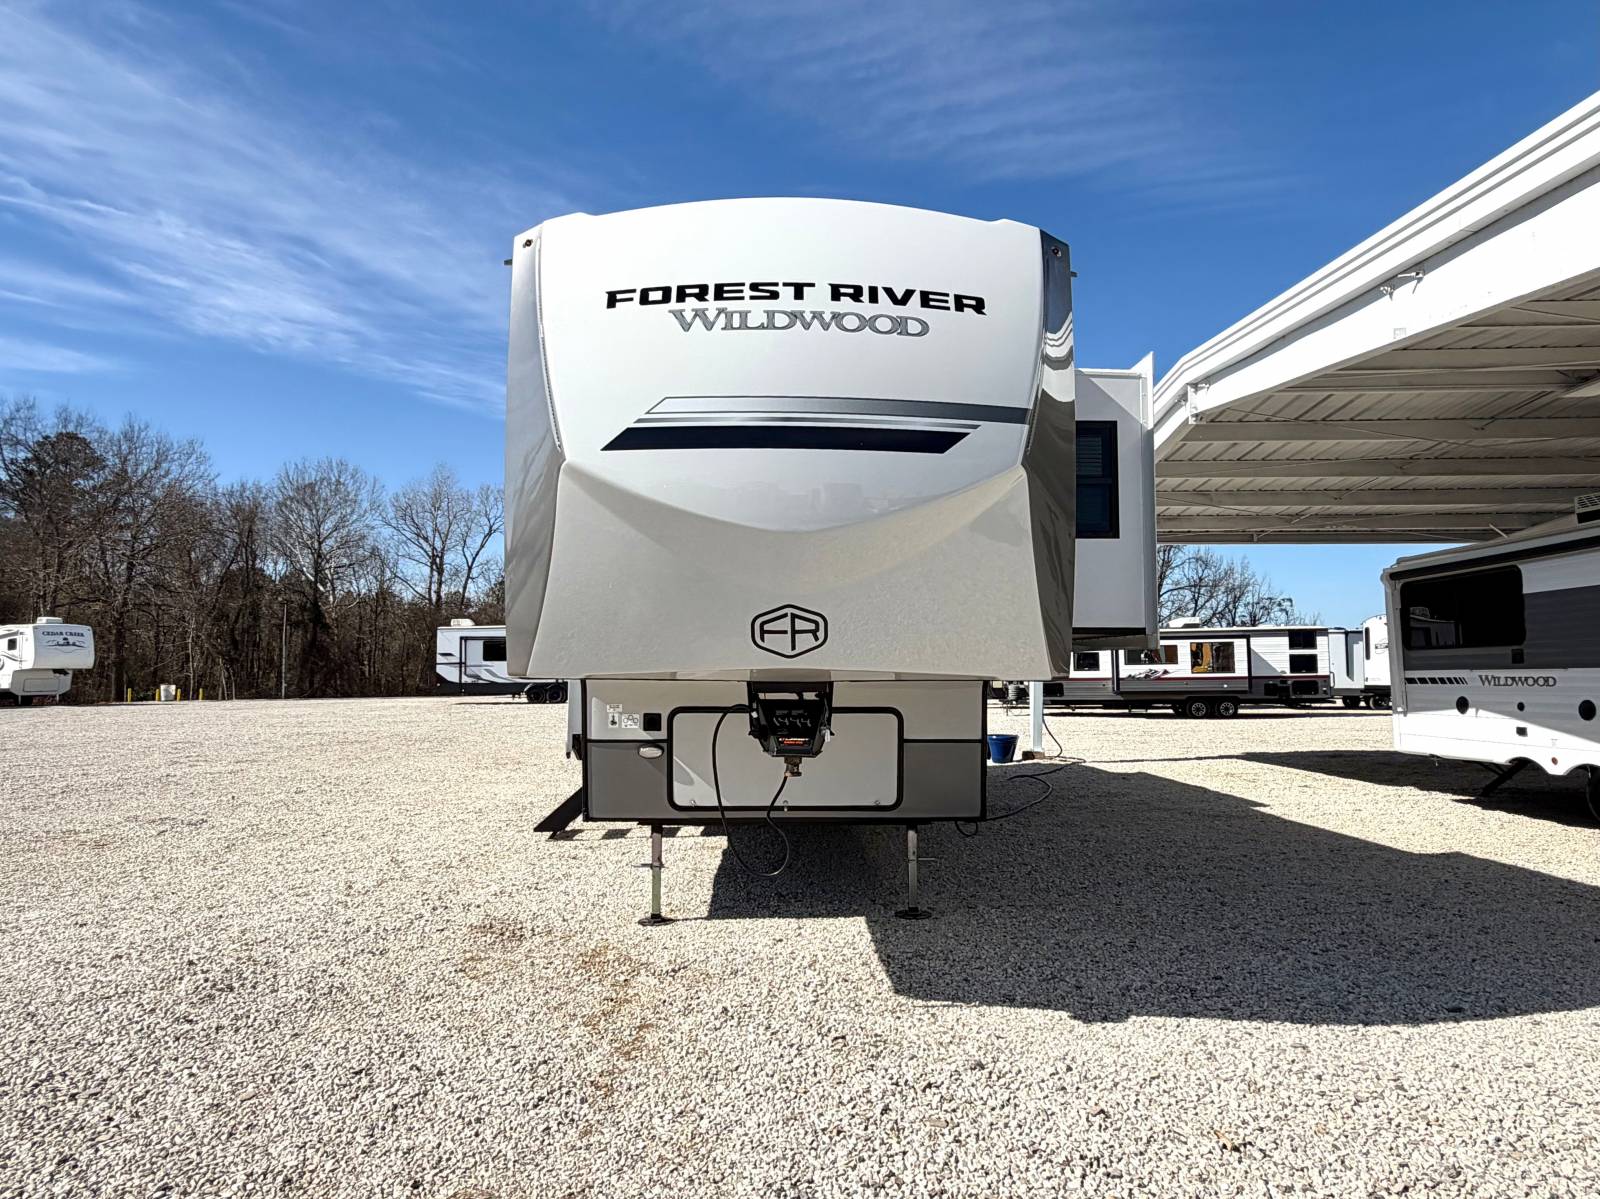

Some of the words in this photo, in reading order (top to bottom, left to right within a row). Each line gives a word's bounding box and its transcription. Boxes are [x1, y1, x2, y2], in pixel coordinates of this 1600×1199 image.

[605, 281, 815, 308] FOREST
[827, 282, 988, 315] RIVER
[669, 308, 931, 337] WILDWOOD
[1479, 675, 1557, 687] WILDWOOD
